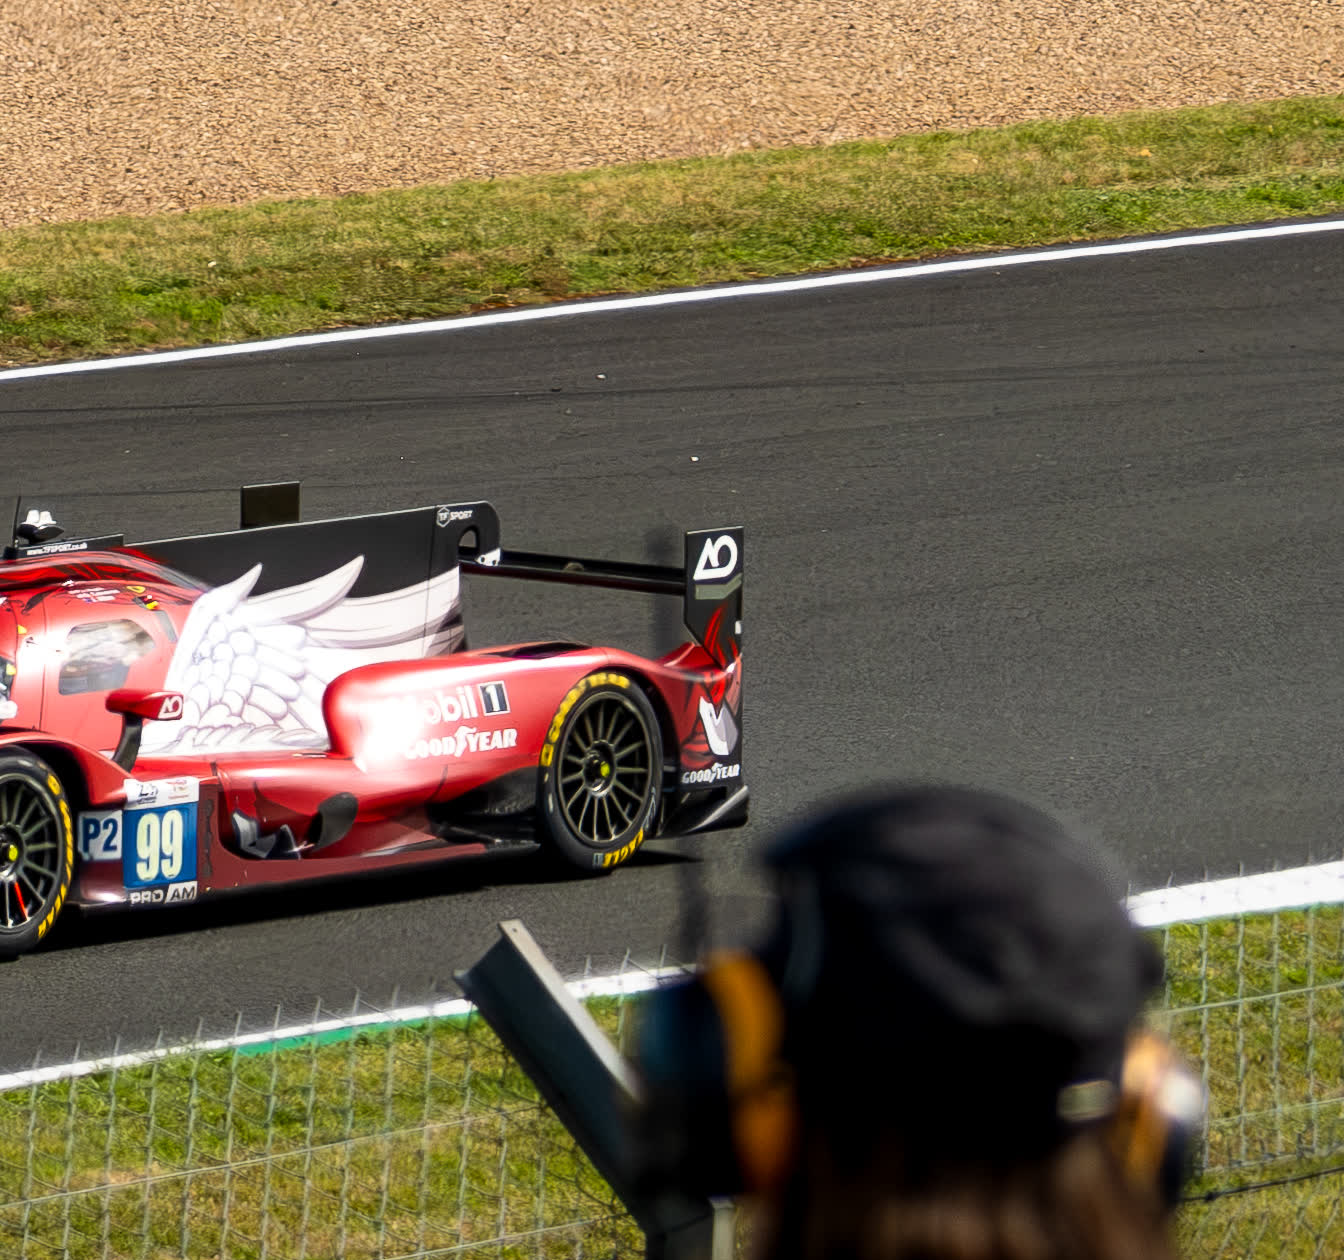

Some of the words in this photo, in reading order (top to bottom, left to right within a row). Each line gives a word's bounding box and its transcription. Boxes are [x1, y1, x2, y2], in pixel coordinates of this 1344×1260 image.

[450, 510, 473, 520] SPORT
[681, 762, 740, 783] GOODYEAR
[82, 817, 119, 853] P2
[136, 809, 184, 881] 99
[130, 889, 164, 904] PRO
[171, 886, 196, 901] AM
